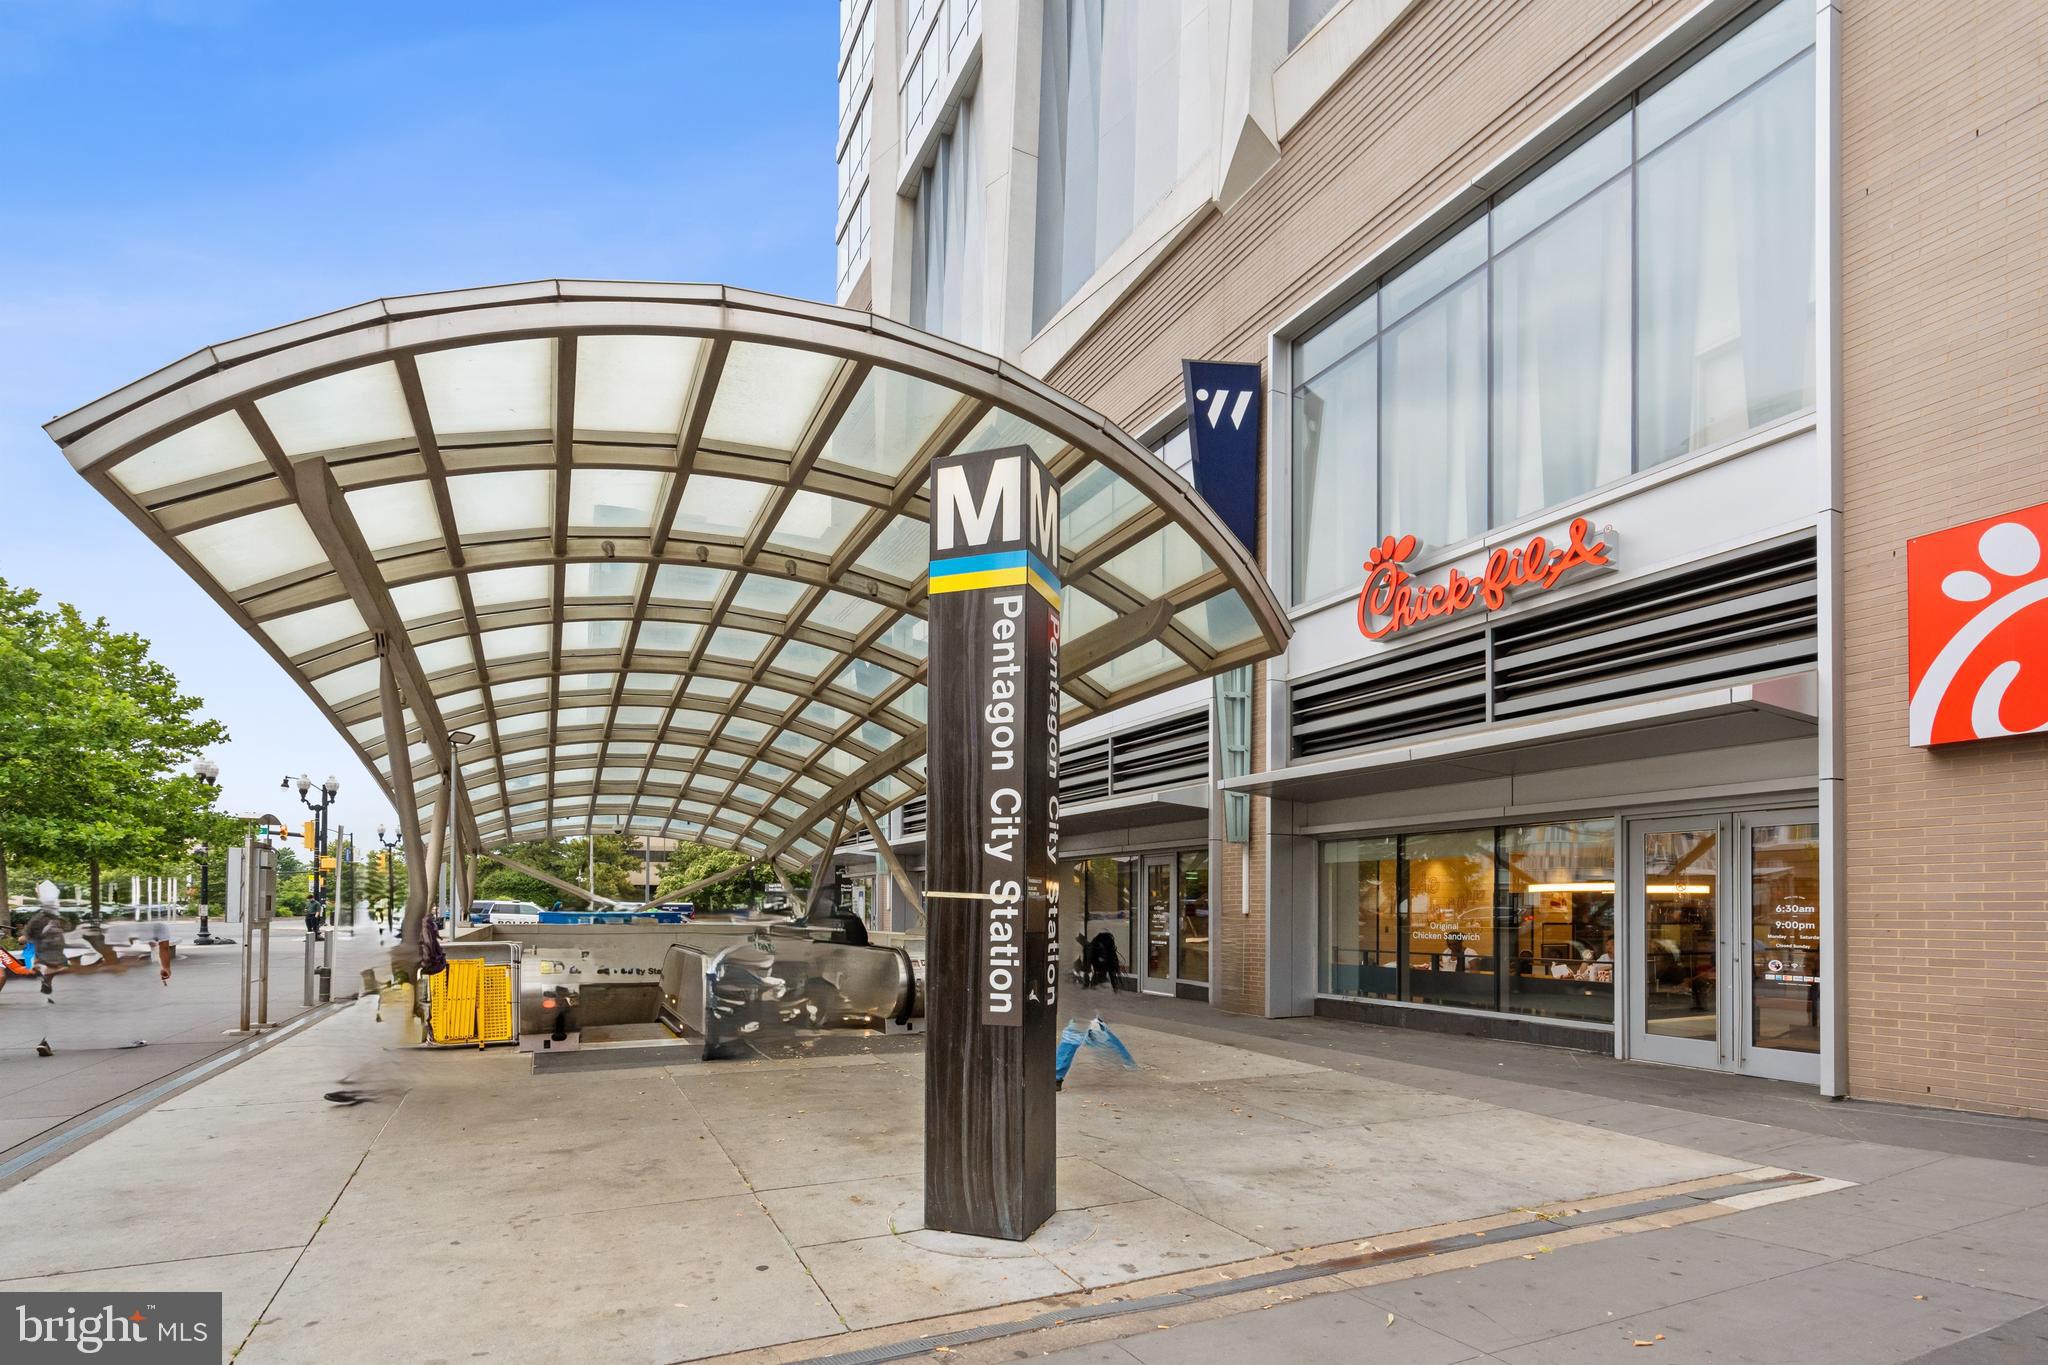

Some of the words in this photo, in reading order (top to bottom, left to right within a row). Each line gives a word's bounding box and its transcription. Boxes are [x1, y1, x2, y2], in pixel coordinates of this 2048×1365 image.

[936, 455, 1022, 551] M
[1030, 459, 1059, 568] M
[984, 594, 1024, 771] Pentagon
[1047, 614, 1060, 779] Pentagon
[985, 788, 1022, 862] City
[1046, 795, 1060, 865] City
[1412, 931, 1441, 940] Chicken
[1443, 932, 1480, 941] Sandwich
[1430, 922, 1459, 931] Original
[1775, 904, 1815, 913] 6:30am
[1775, 921, 1815, 931] 9:00pm
[989, 880, 1022, 1013] Station
